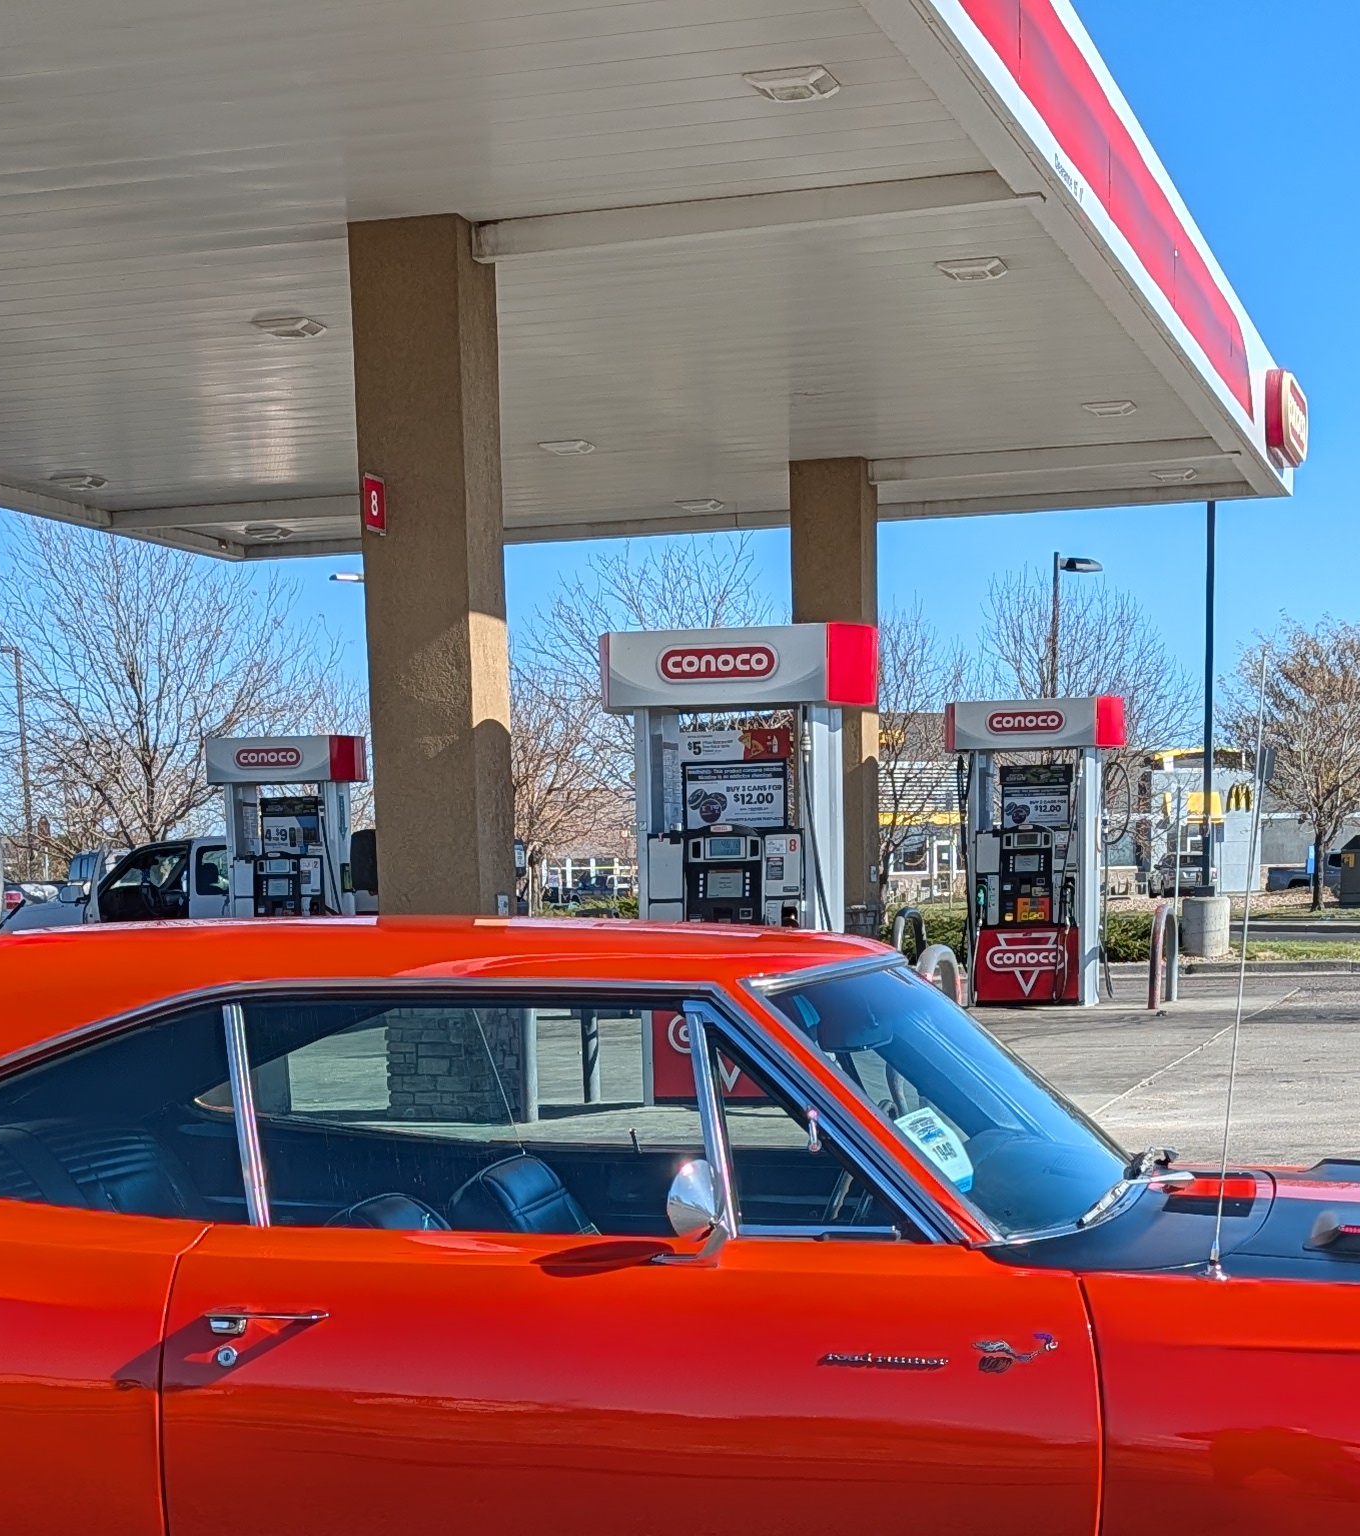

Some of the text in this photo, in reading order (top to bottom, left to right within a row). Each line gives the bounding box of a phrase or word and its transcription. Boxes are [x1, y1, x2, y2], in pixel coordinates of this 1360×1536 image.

[371, 490, 378, 516] 8
[687, 741, 702, 755] $5
[733, 793, 774, 805] $12.00
[265, 829, 272, 841] 4
[789, 839, 797, 852] 8
